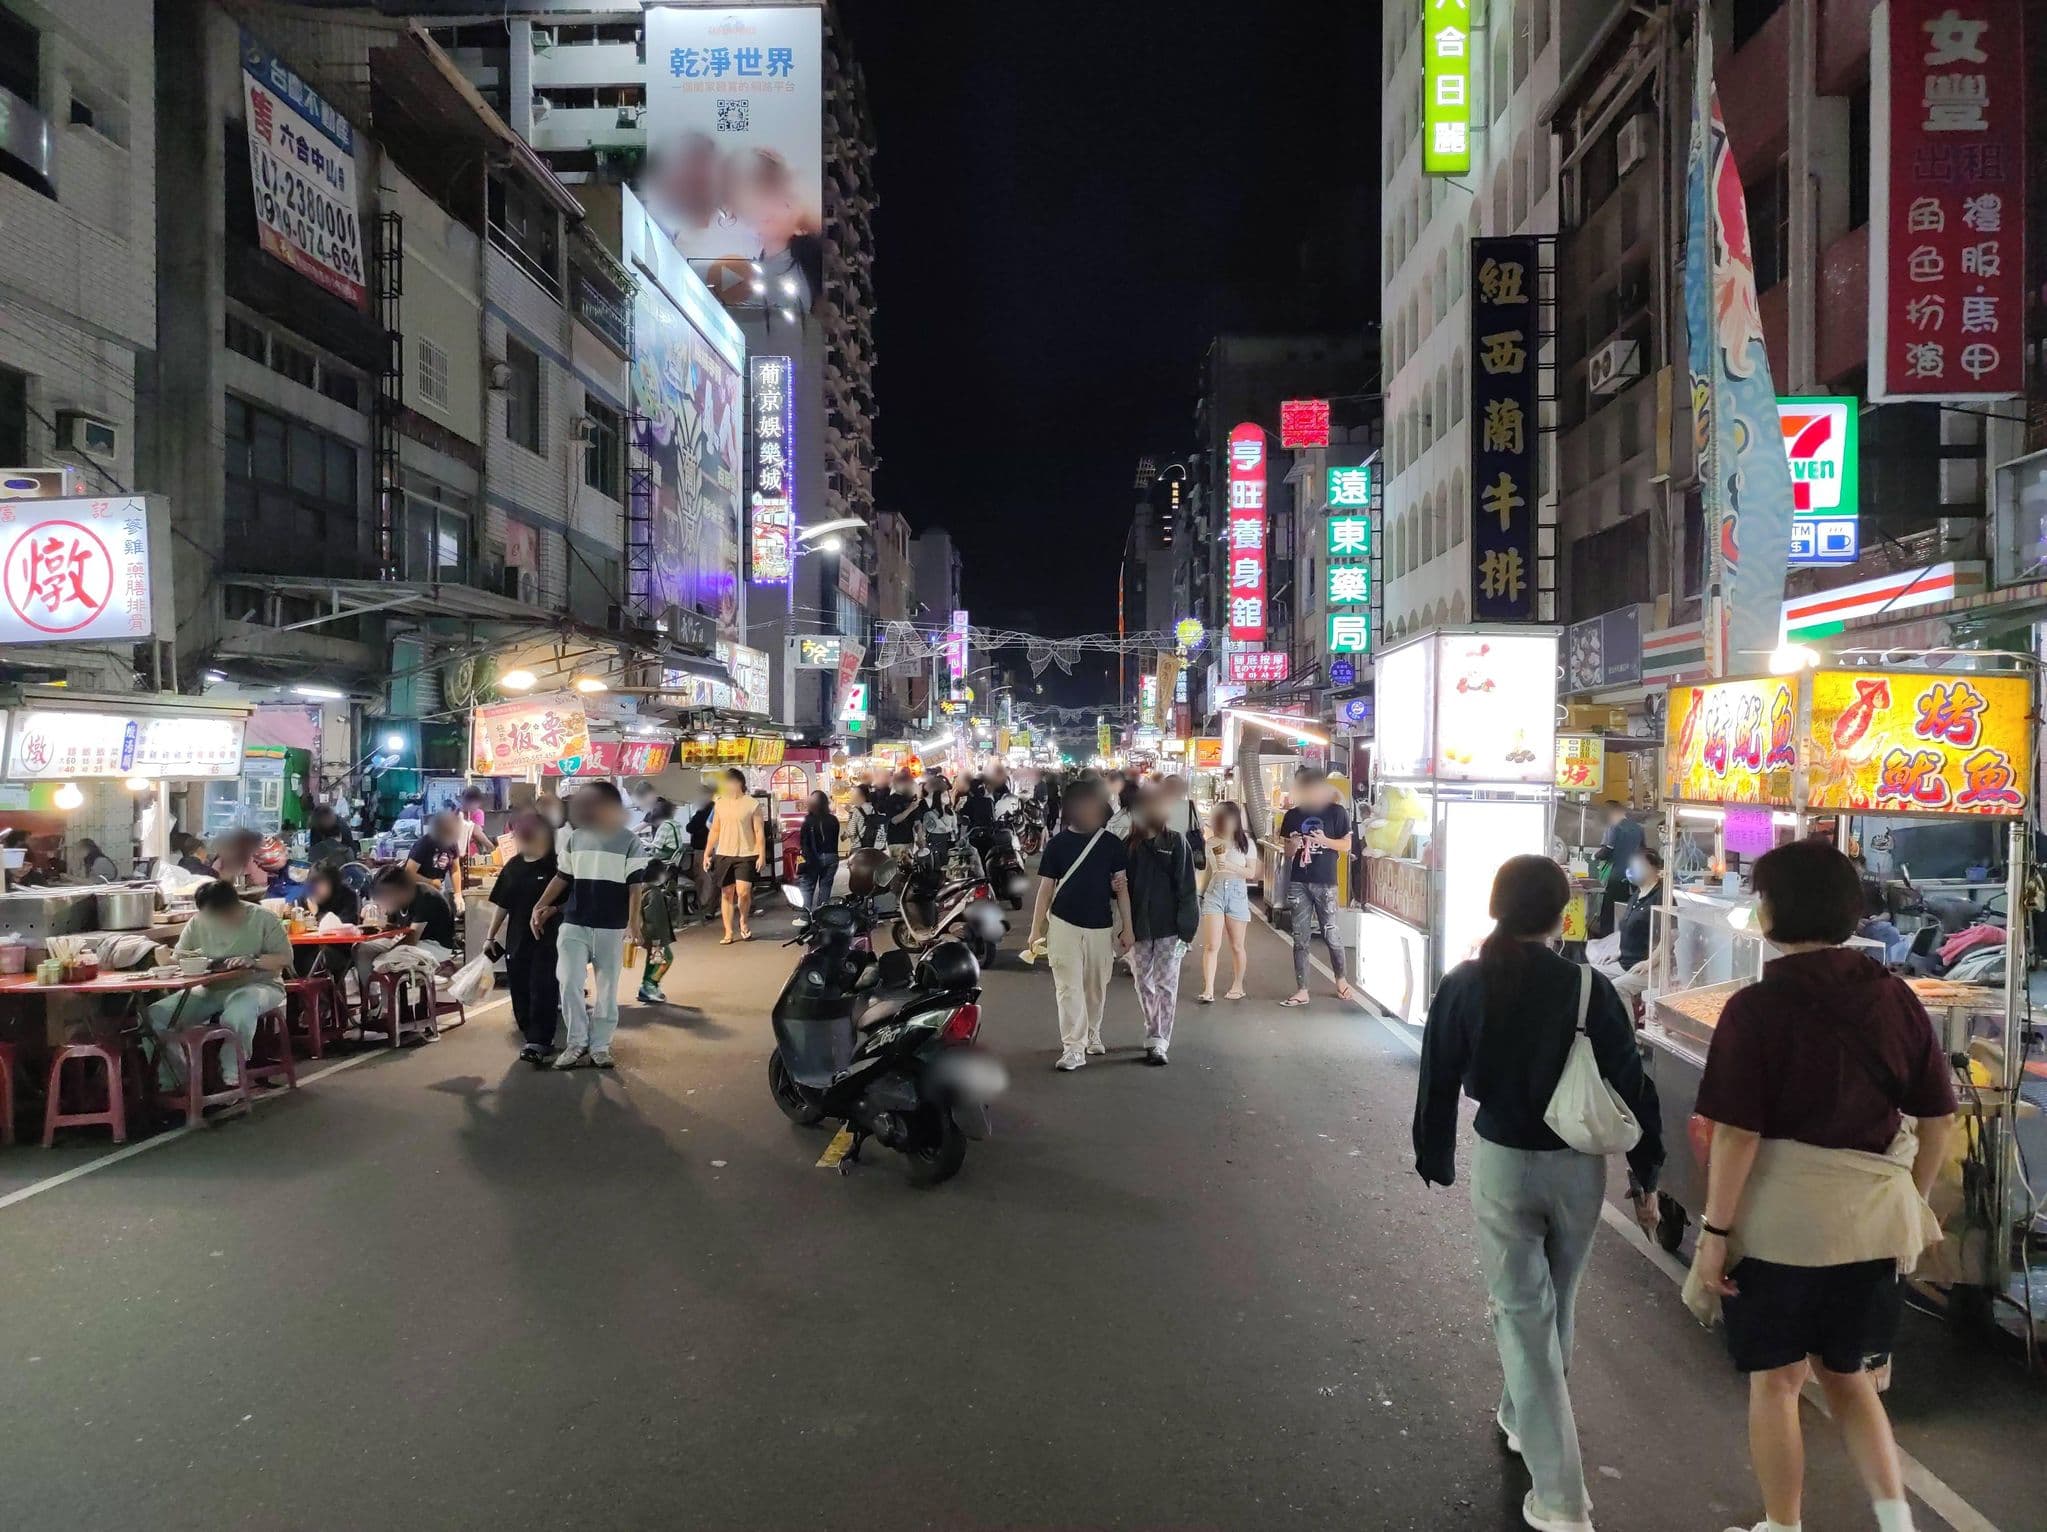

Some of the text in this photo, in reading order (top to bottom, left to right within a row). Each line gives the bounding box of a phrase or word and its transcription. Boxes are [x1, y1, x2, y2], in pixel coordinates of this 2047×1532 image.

[670, 47, 795, 78] 乾淨世界
[1435, 0, 1466, 153] 合日
[280, 123, 337, 188] 六合中山
[1913, 142, 2007, 184] 出租
[1906, 196, 1945, 378] 角色扮演
[759, 363, 783, 491] 葡京娛樂城
[1479, 257, 1529, 603] 紐西蘭牛排
[1330, 469, 1369, 651] 遠東藥局
[1792, 525, 1811, 536] TM
[22, 536, 99, 613] 燉
[125, 562, 146, 632] 藥膳排骨
[1703, 686, 1796, 779] 烤魷魚
[1912, 680, 1988, 750] 烤
[1876, 747, 2028, 809] 魷魚
